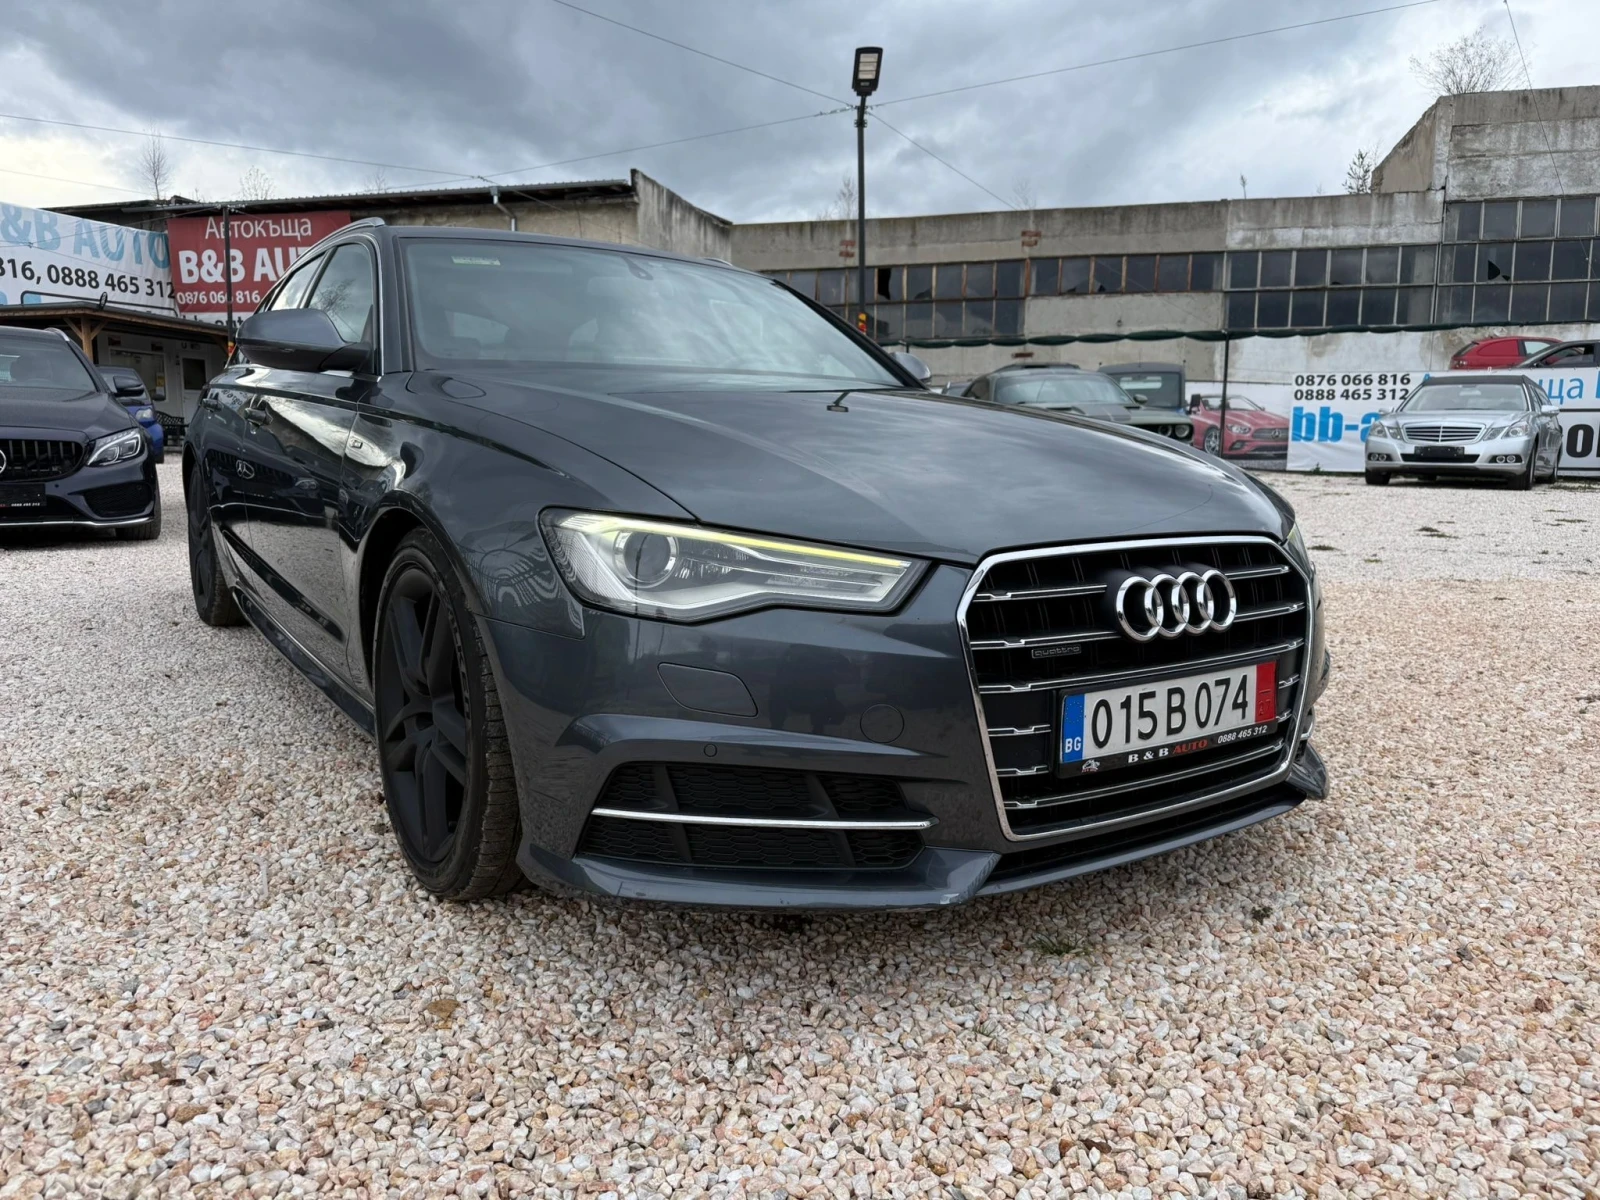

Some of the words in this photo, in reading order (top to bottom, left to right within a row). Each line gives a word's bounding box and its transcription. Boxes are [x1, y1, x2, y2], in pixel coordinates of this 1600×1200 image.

[73, 218, 171, 269] AUTO
[178, 249, 246, 284] B&B
[47, 264, 100, 289] 0888
[105, 273, 140, 294] 465
[145, 278, 176, 299] 312
[176, 291, 208, 305] 0876
[235, 290, 261, 304] 816
[1294, 374, 1337, 386] 0876
[1341, 374, 1374, 386] 066
[1377, 373, 1411, 386] 816
[1294, 388, 1336, 401] 0888
[1340, 388, 1372, 400] 465
[1376, 388, 1410, 400] 312
[1034, 646, 1080, 657] quattro
[1064, 736, 1082, 753] BG
[1128, 753, 1139, 763] B
[1143, 751, 1154, 760] &
[1158, 748, 1169, 757] B
[1173, 739, 1208, 754] AUTO
[1217, 732, 1237, 744] 0888
[1237, 729, 1252, 740] 465
[1253, 725, 1268, 736] 312
